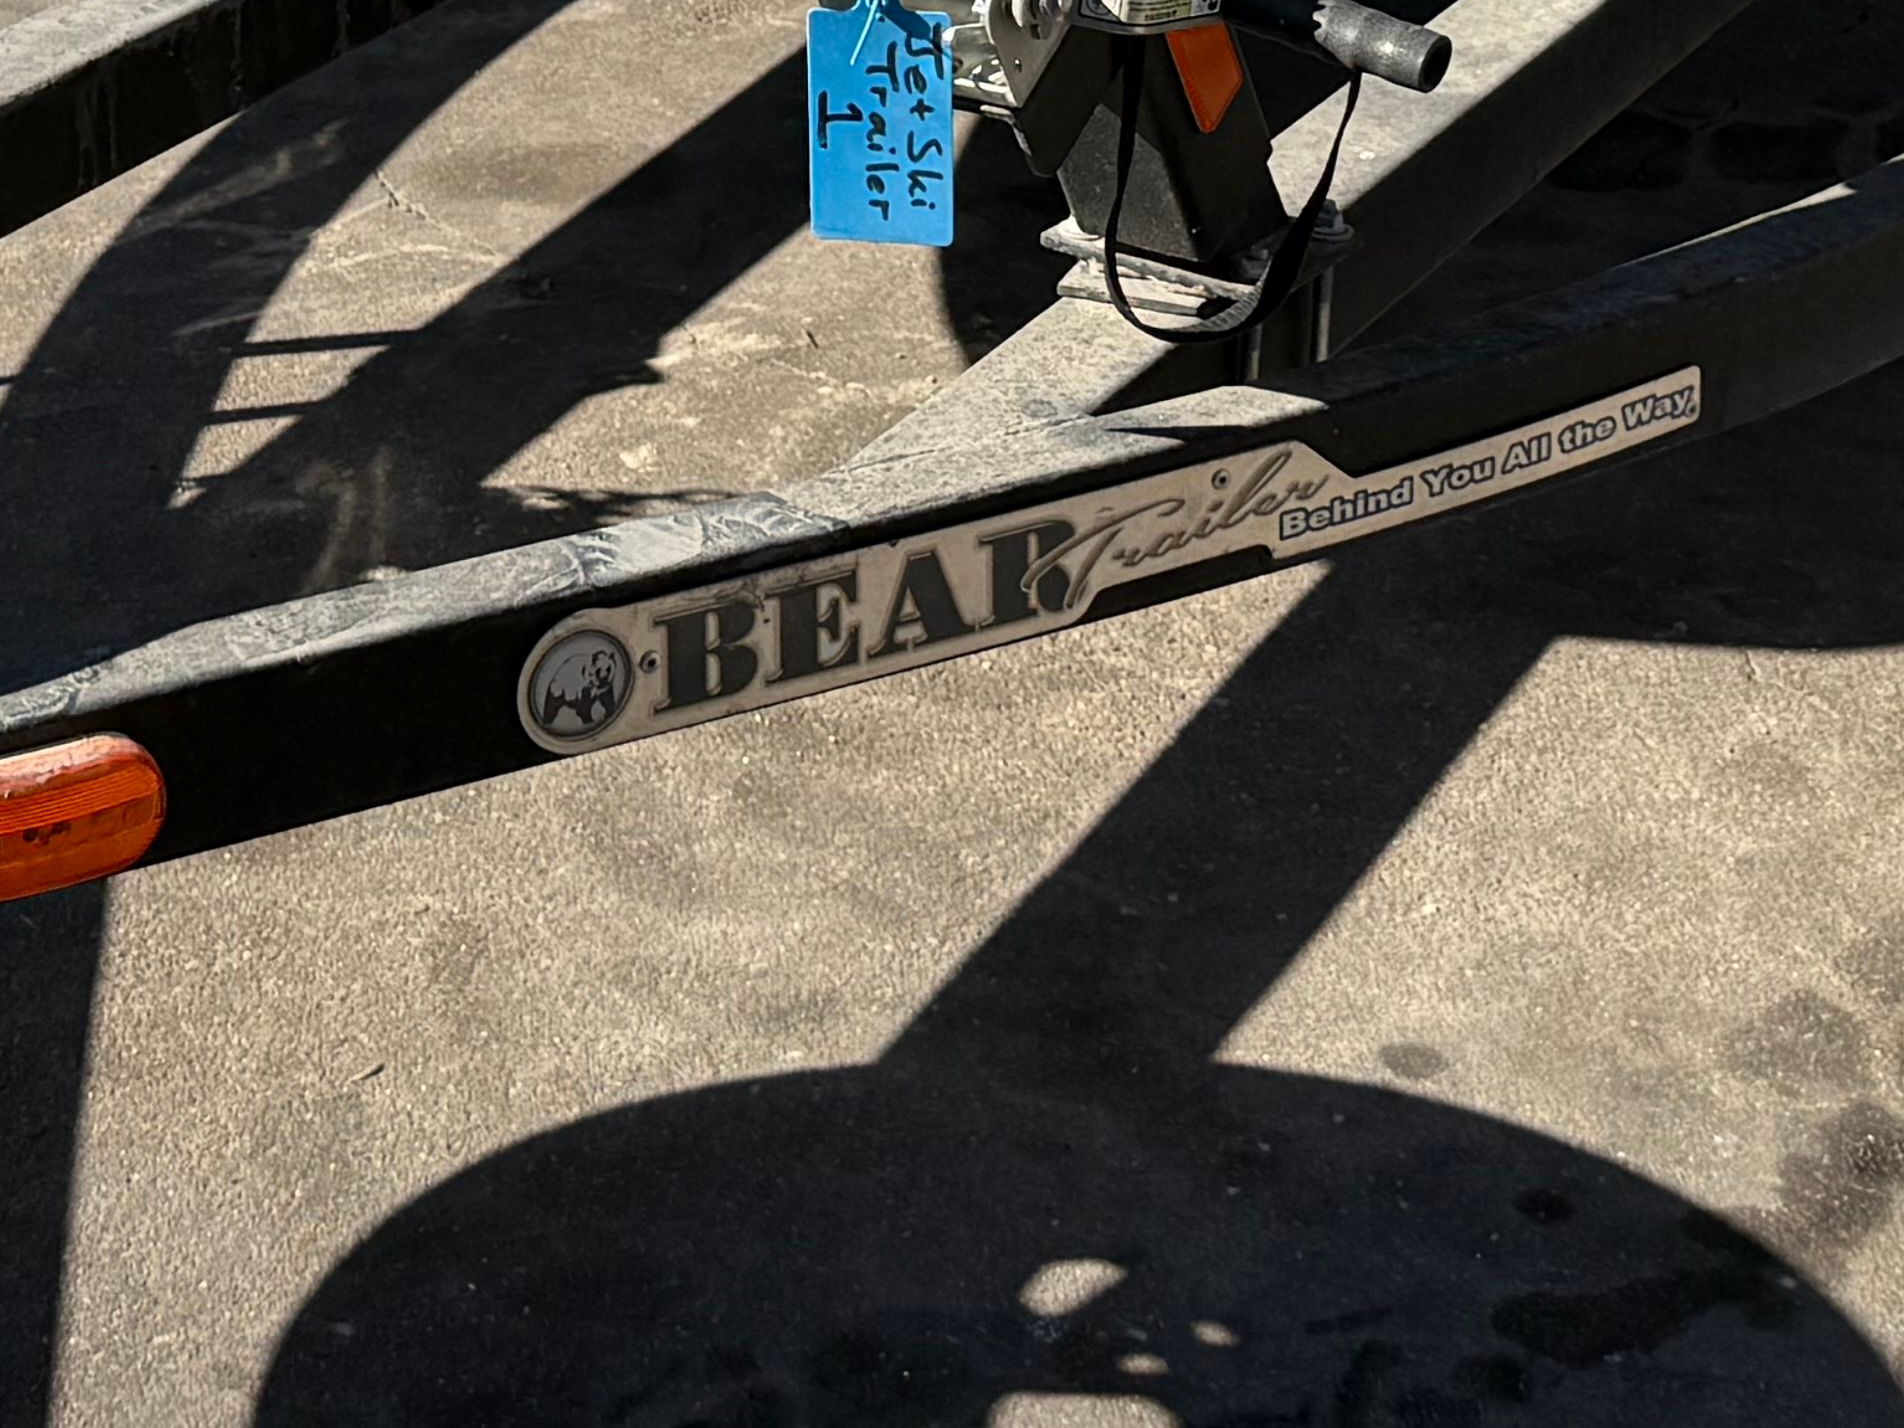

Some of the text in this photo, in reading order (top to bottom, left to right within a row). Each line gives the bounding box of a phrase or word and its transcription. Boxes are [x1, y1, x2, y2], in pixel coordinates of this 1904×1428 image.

[865, 41, 900, 221] Trailer
[903, 21, 943, 210] Jet Ski
[1020, 447, 1329, 611] Trailer
[1278, 481, 1413, 541] Behind
[1421, 452, 1494, 494] You
[1501, 431, 1552, 474] All
[1558, 413, 1616, 454] the
[652, 518, 1077, 714] BEAR
